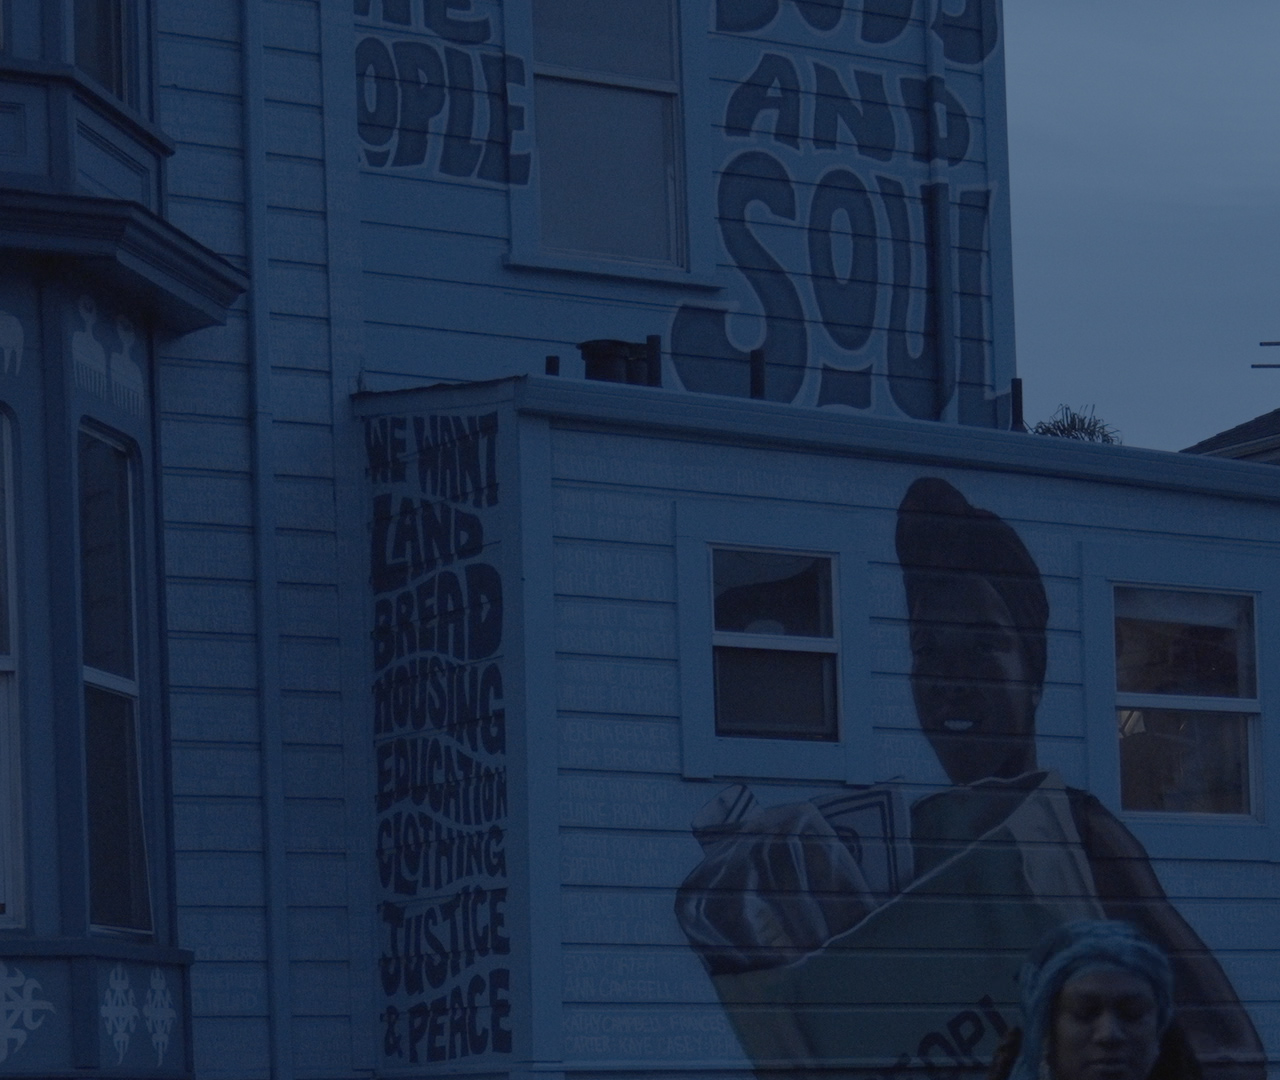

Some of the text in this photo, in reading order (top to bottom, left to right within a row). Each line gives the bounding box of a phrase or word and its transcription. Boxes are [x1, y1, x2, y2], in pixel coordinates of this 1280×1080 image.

[724, 52, 971, 167] AND
[365, 416, 407, 486] WE
[413, 412, 499, 509] WANT
[369, 492, 484, 593] LAND
[372, 562, 504, 673] BREAD
[373, 662, 506, 756] HOUSING
[375, 736, 508, 827] EDUCATION
[375, 809, 506, 896] CLOTHING
[378, 885, 511, 998] JUSTICE
[382, 967, 513, 1064] & PEACE
